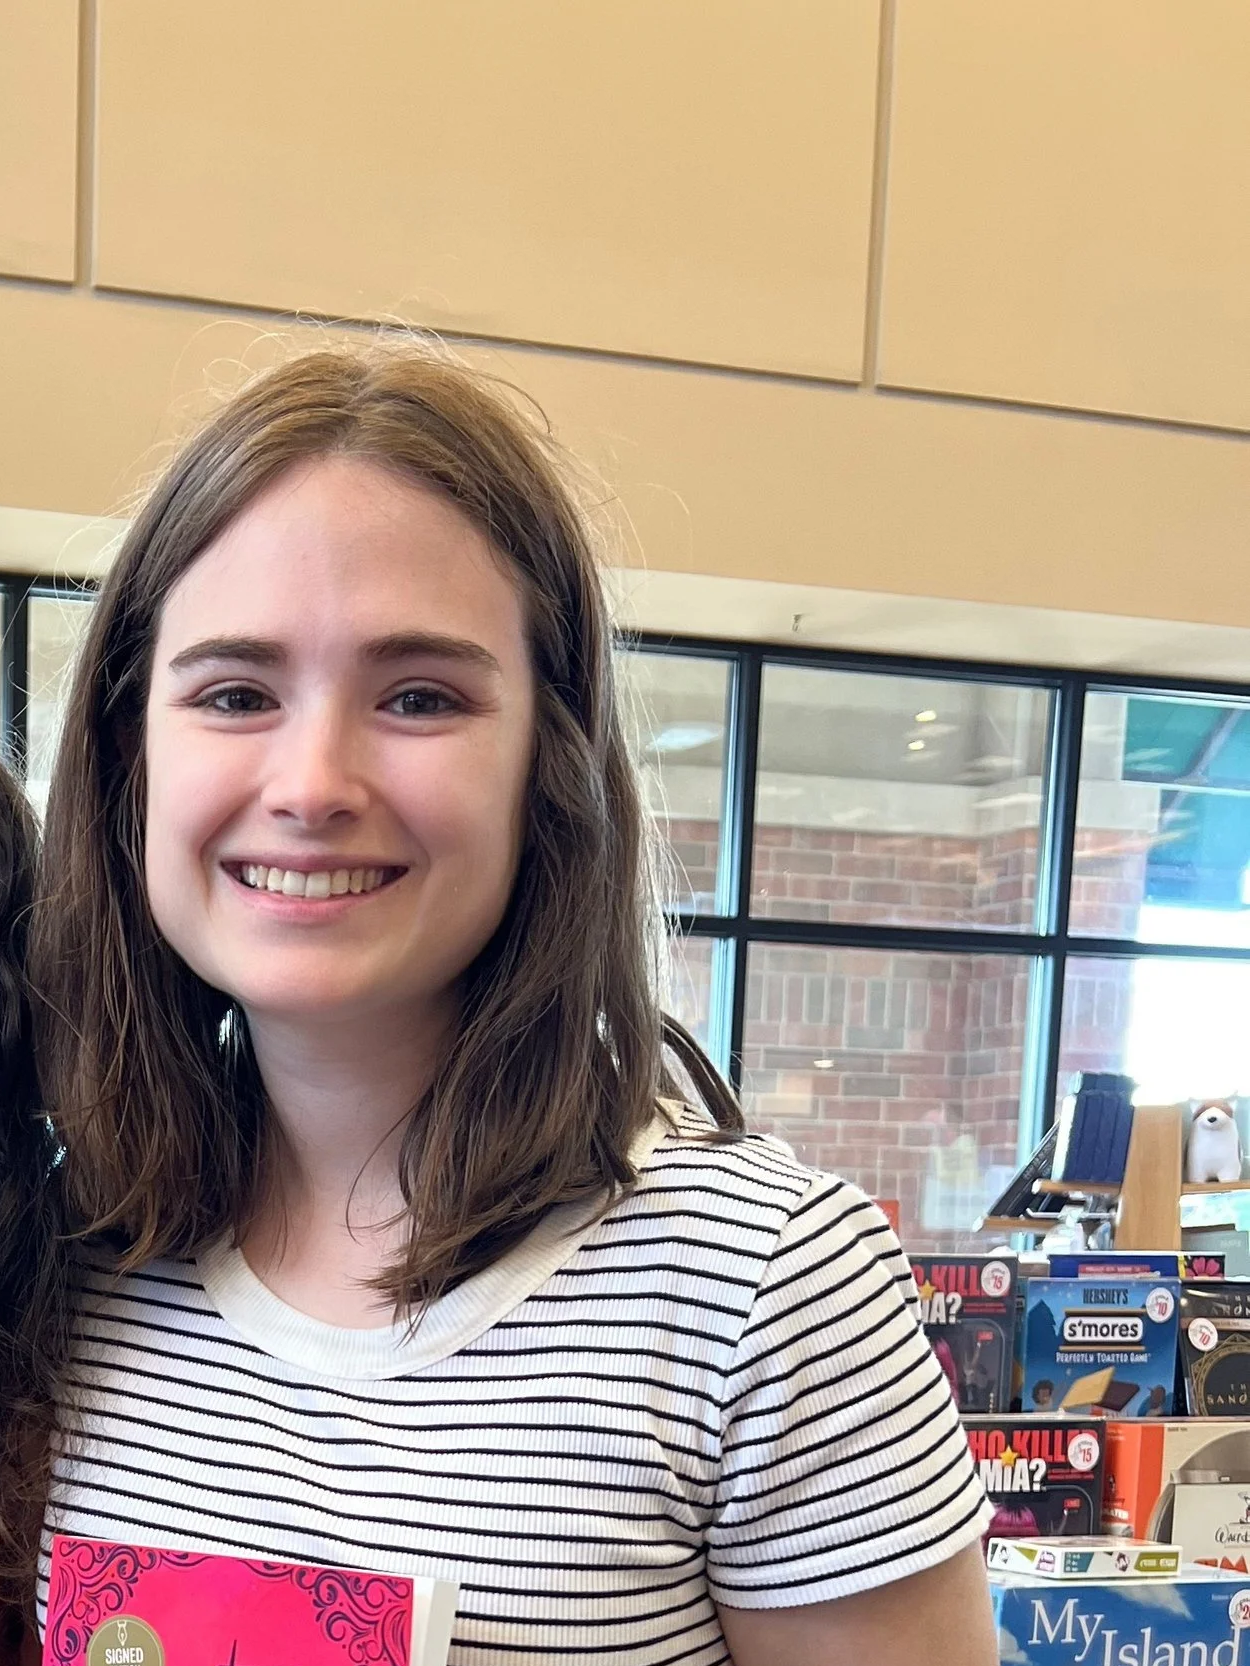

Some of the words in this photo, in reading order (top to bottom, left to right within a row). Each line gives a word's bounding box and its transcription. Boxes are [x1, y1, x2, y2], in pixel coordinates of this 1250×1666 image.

[1083, 1288, 1128, 1304] HERSHEY'S
[1068, 1319, 1139, 1338] s'mores
[1056, 1352, 1094, 1364] PERFECTLY
[1097, 1352, 1128, 1364] TOASTED
[1027, 1598, 1104, 1662] My
[105, 1647, 144, 1665] SIGNED
